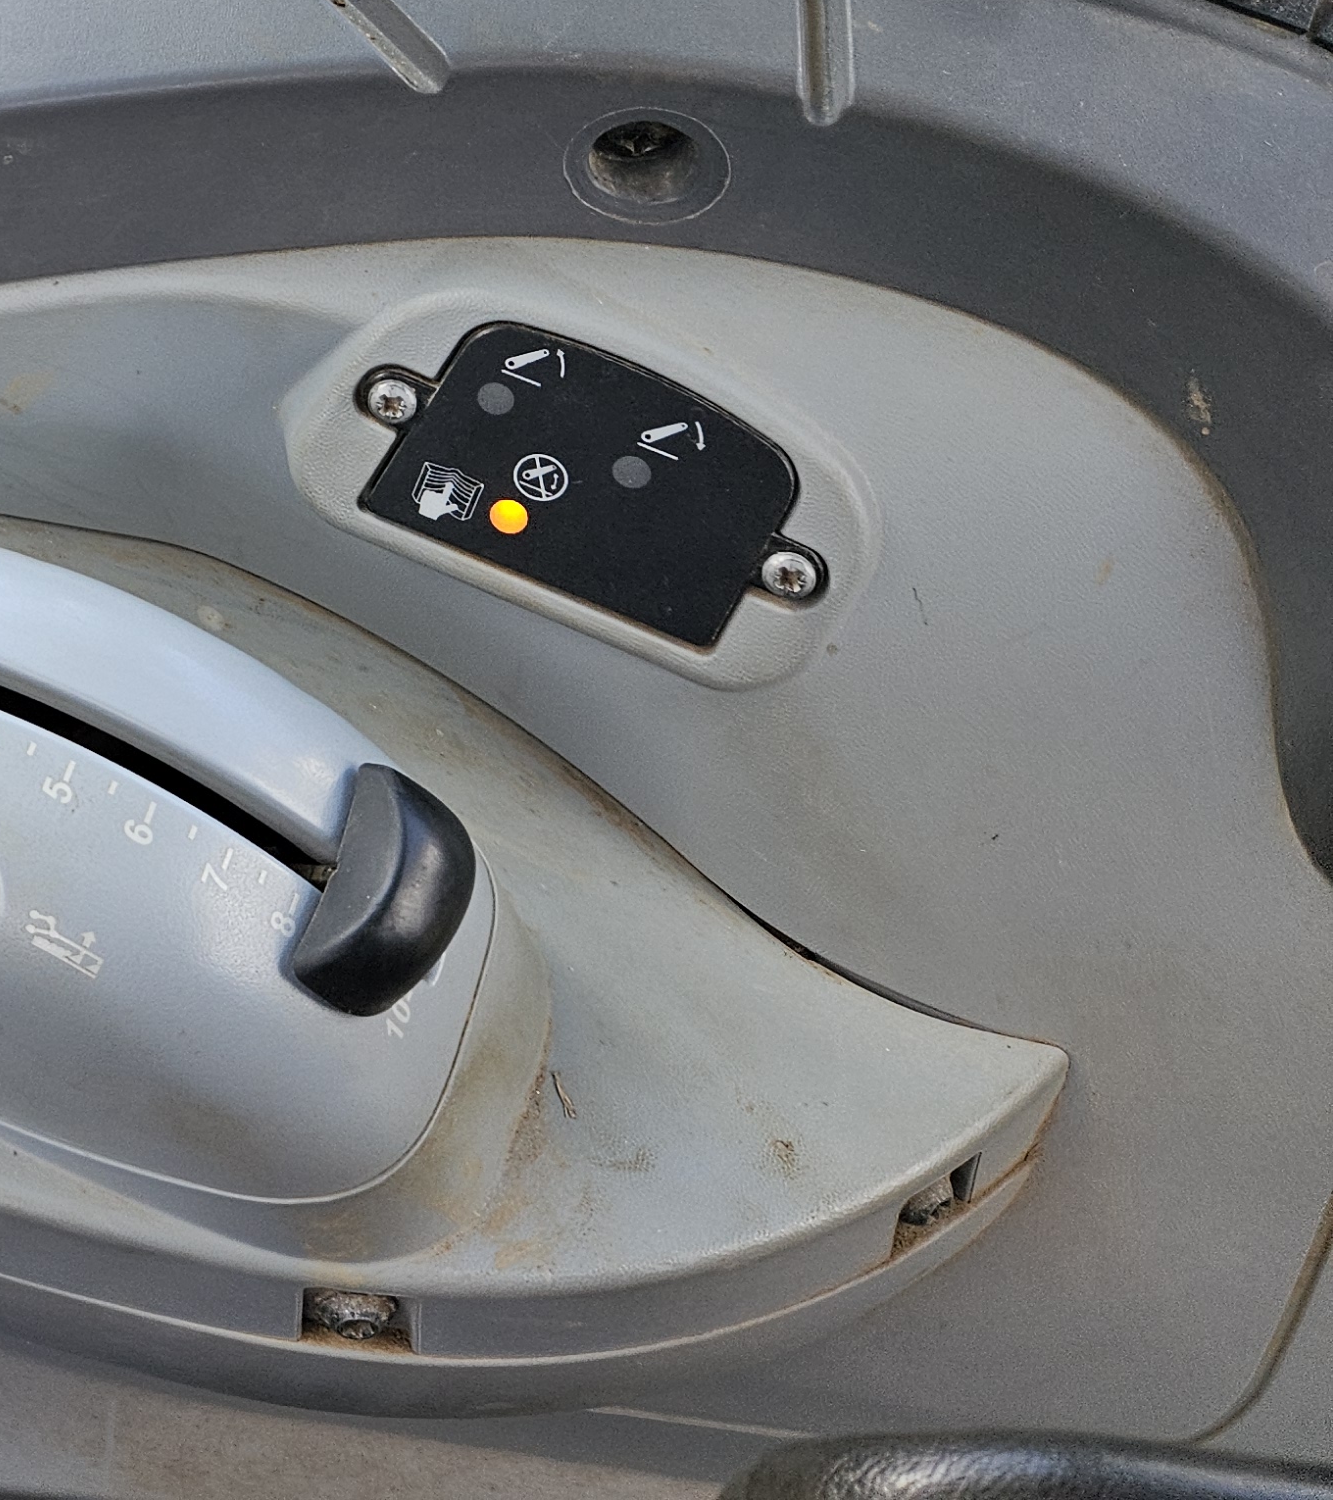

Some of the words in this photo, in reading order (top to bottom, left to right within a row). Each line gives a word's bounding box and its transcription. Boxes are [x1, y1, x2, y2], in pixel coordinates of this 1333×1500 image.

[41, 775, 74, 804] 5
[123, 818, 155, 846] 6
[200, 861, 229, 891] 7
[270, 909, 297, 938] 8
[385, 999, 411, 1039] 10
